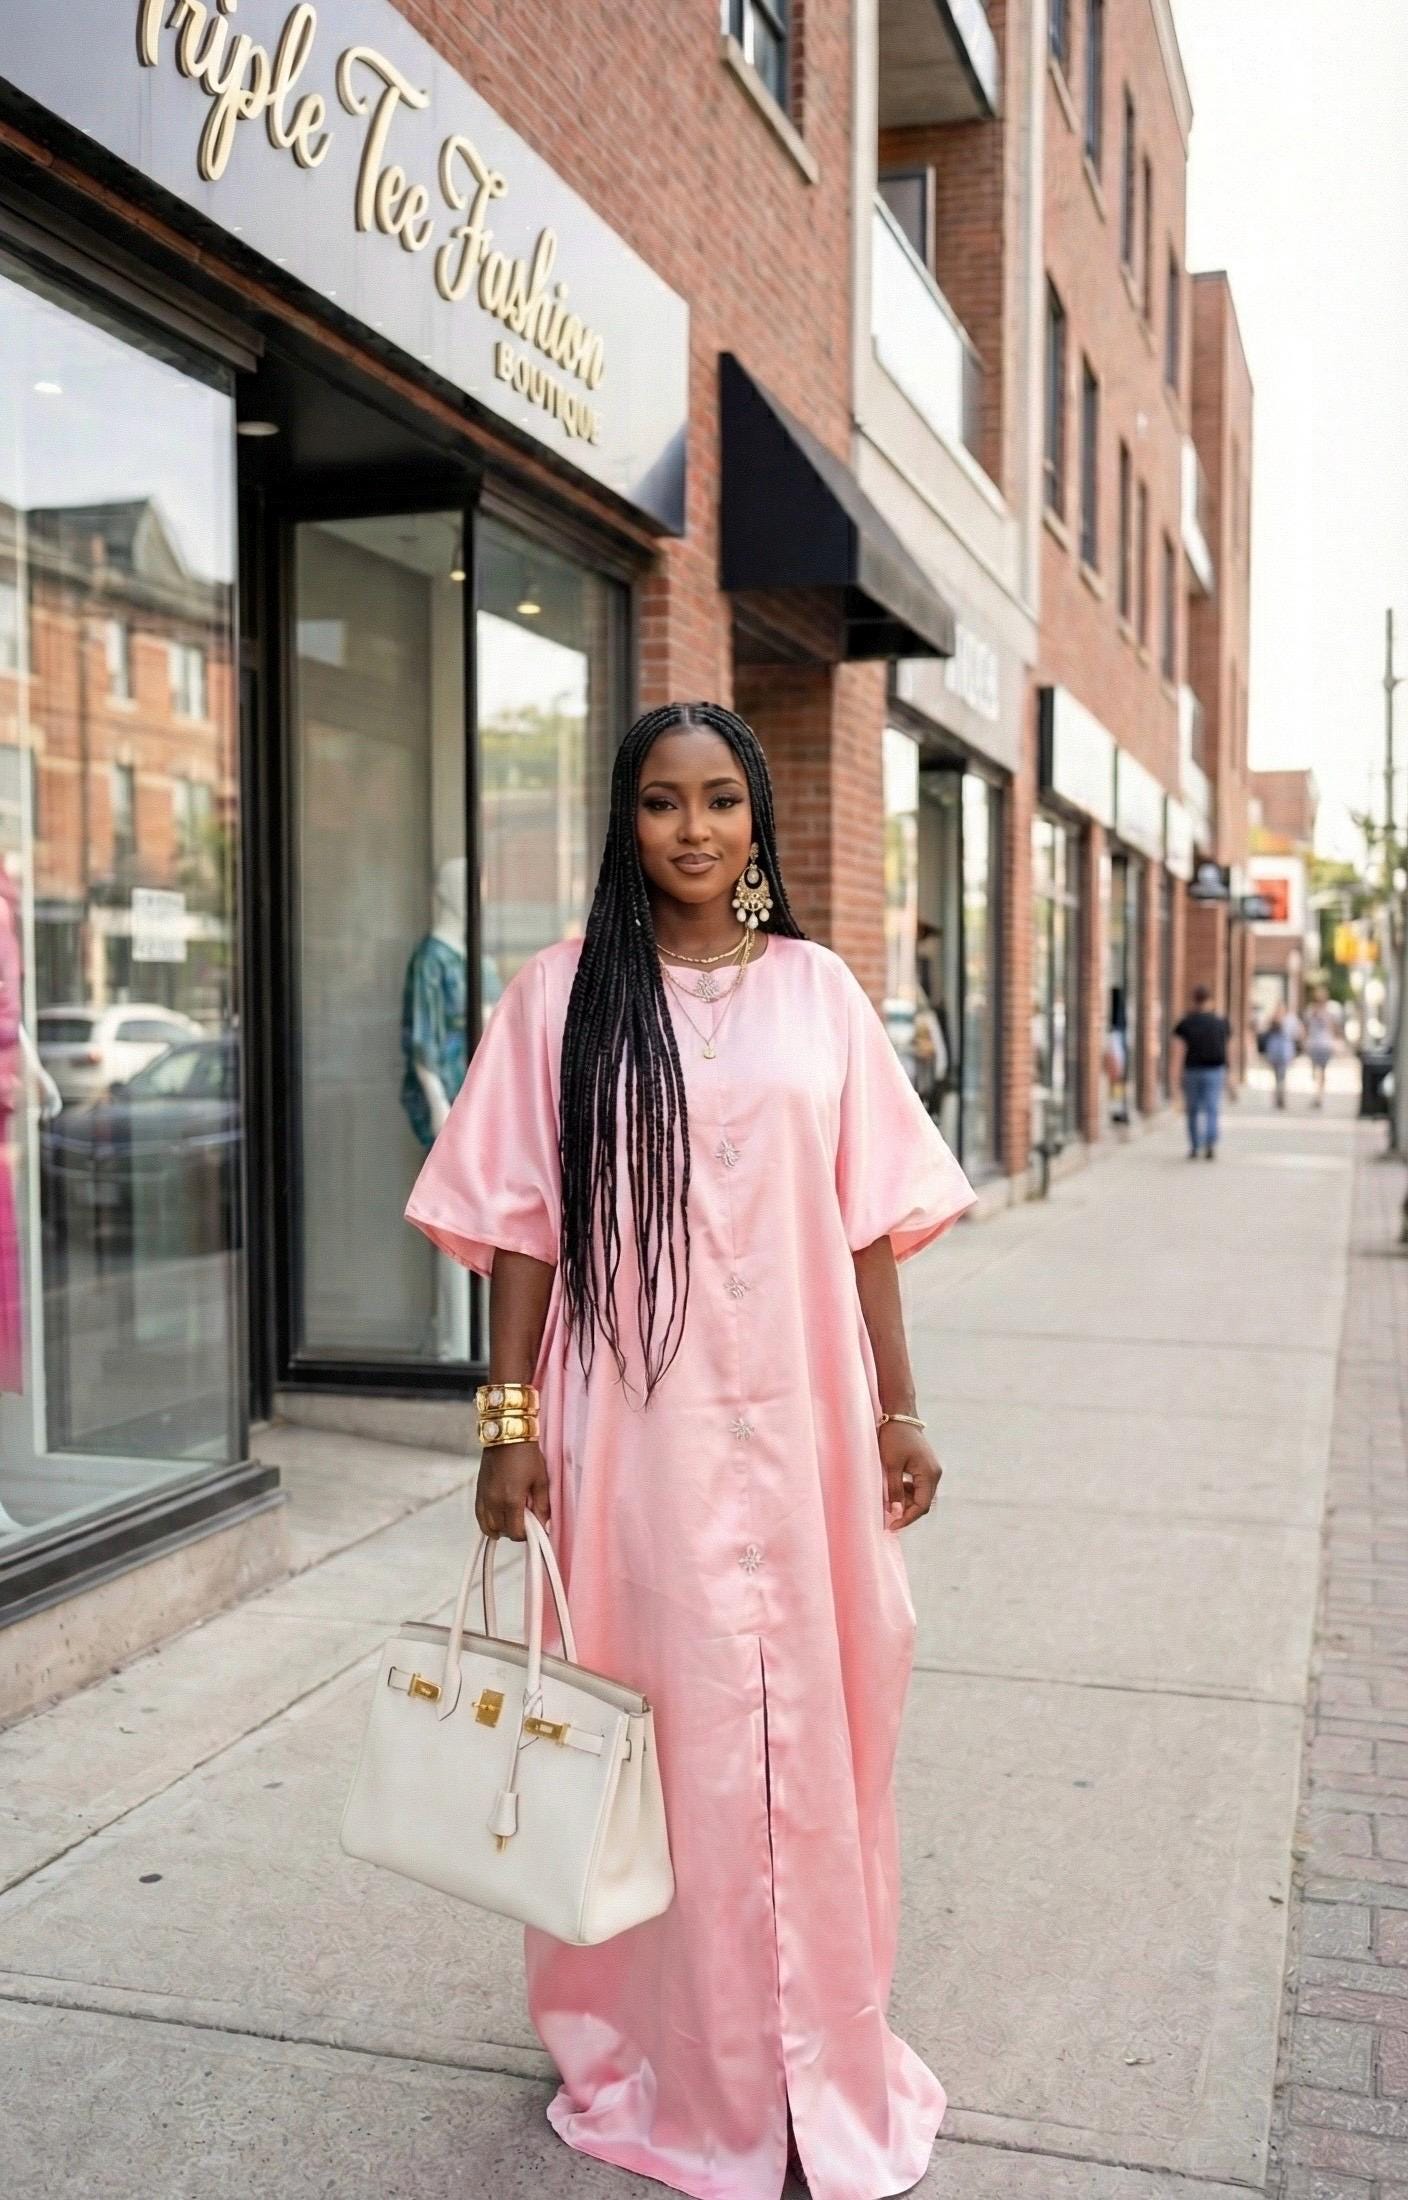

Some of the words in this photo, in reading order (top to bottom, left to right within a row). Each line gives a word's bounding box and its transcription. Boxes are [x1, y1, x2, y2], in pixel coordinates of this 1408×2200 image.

[335, 46, 434, 252] Tee
[434, 134, 605, 390] Fashion
[493, 340, 600, 445] BOUTIQUE
